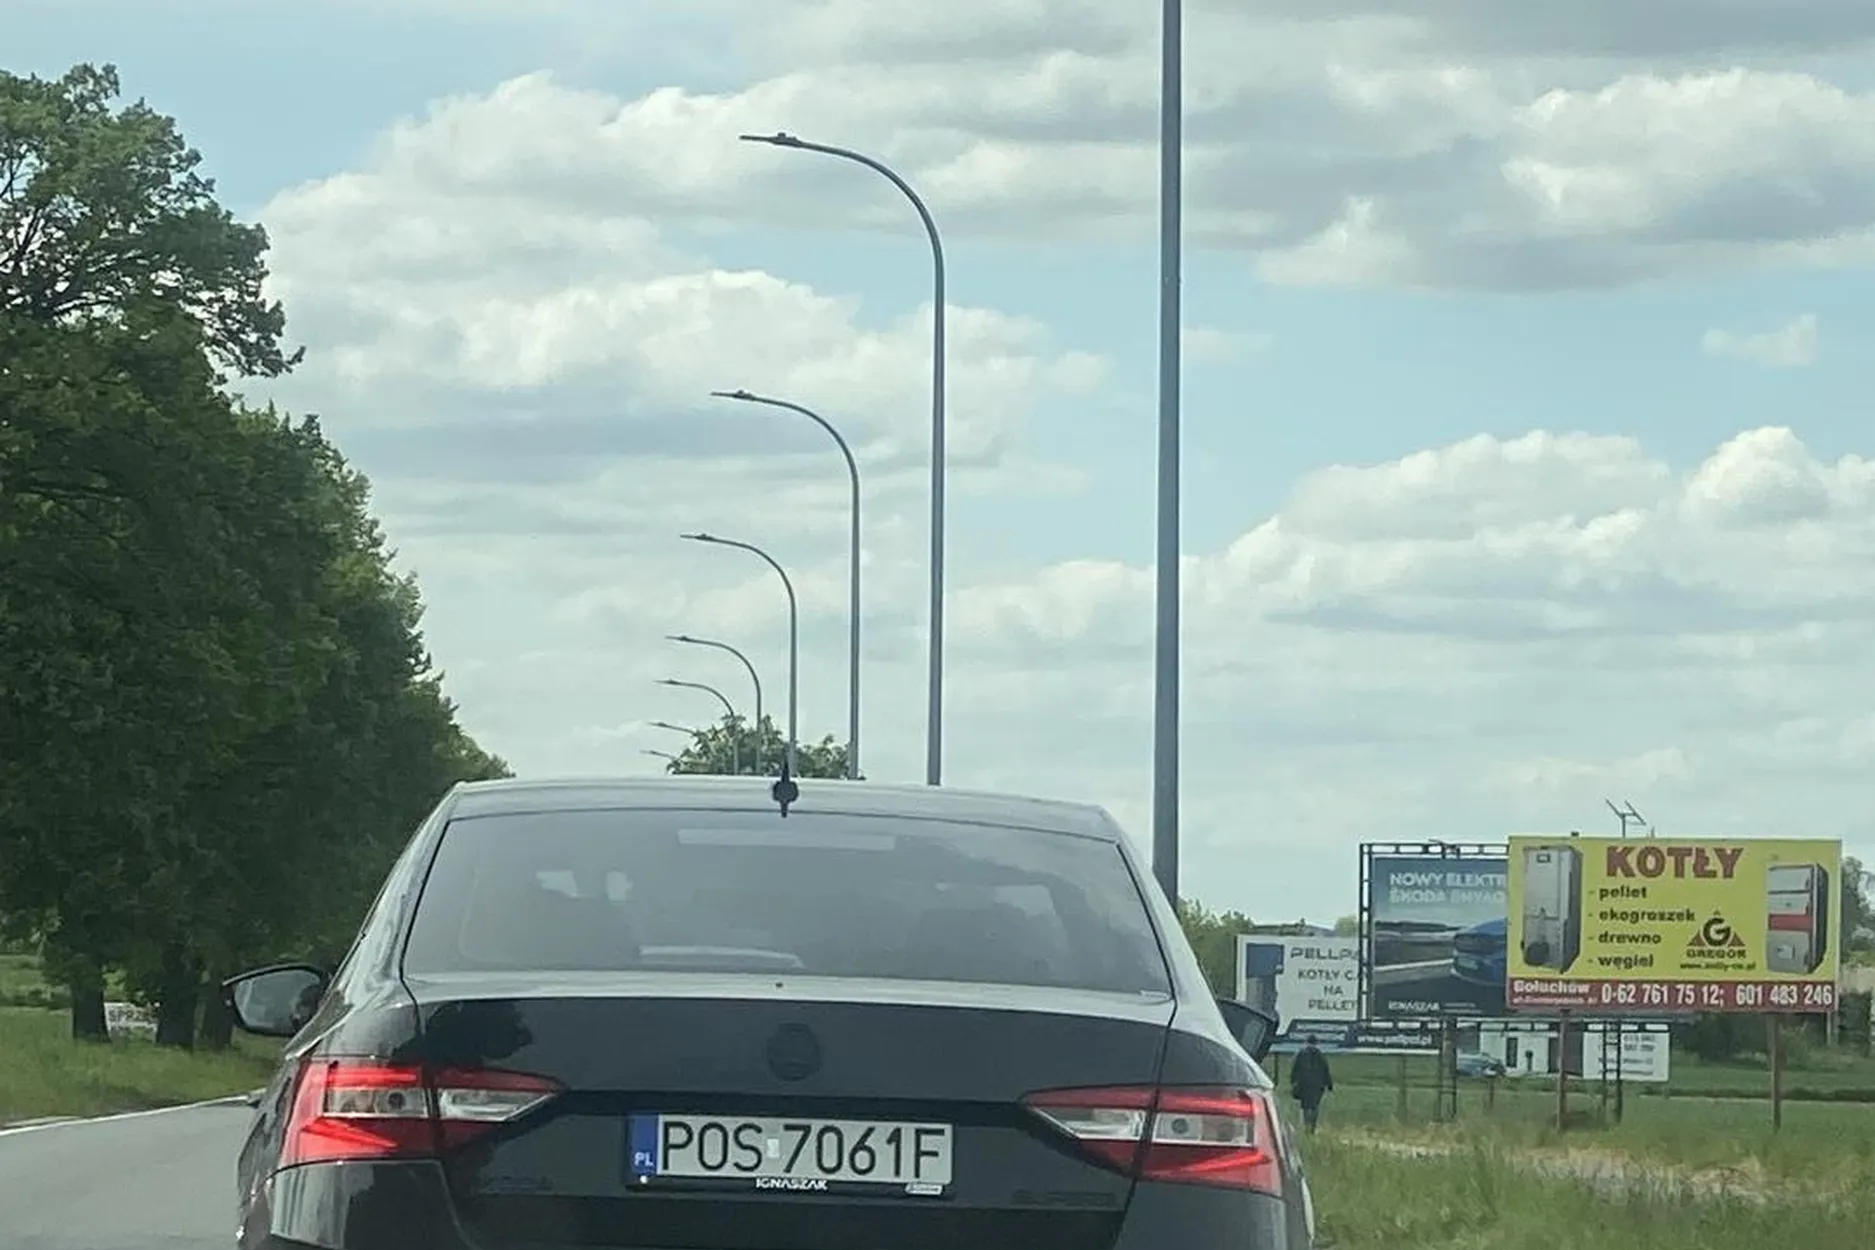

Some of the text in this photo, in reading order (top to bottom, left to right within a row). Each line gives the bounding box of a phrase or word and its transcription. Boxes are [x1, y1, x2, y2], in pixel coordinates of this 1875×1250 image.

[1606, 846, 1744, 879] KOTŁY
[1389, 873, 1443, 886] NOWY
[1389, 887, 1446, 903] ŠKODA
[1599, 885, 1647, 901] pellet
[1599, 908, 1696, 924] ekogroszek
[1598, 931, 1662, 944] drewno
[1598, 954, 1654, 969] węgiel
[1686, 949, 1746, 959] GREGOR
[1298, 969, 1340, 980] KOTŁY
[1324, 985, 1343, 995] NA
[1601, 983, 1636, 1003] 0-62
[1643, 984, 1668, 1004] 761
[1676, 984, 1695, 1004] 75
[1736, 985, 1763, 1005] 601
[1803, 985, 1833, 1005] 246
[662, 1121, 946, 1179] POS 7061F
[634, 1152, 653, 1167] PL
[756, 1177, 828, 1191] IGNASZAK
